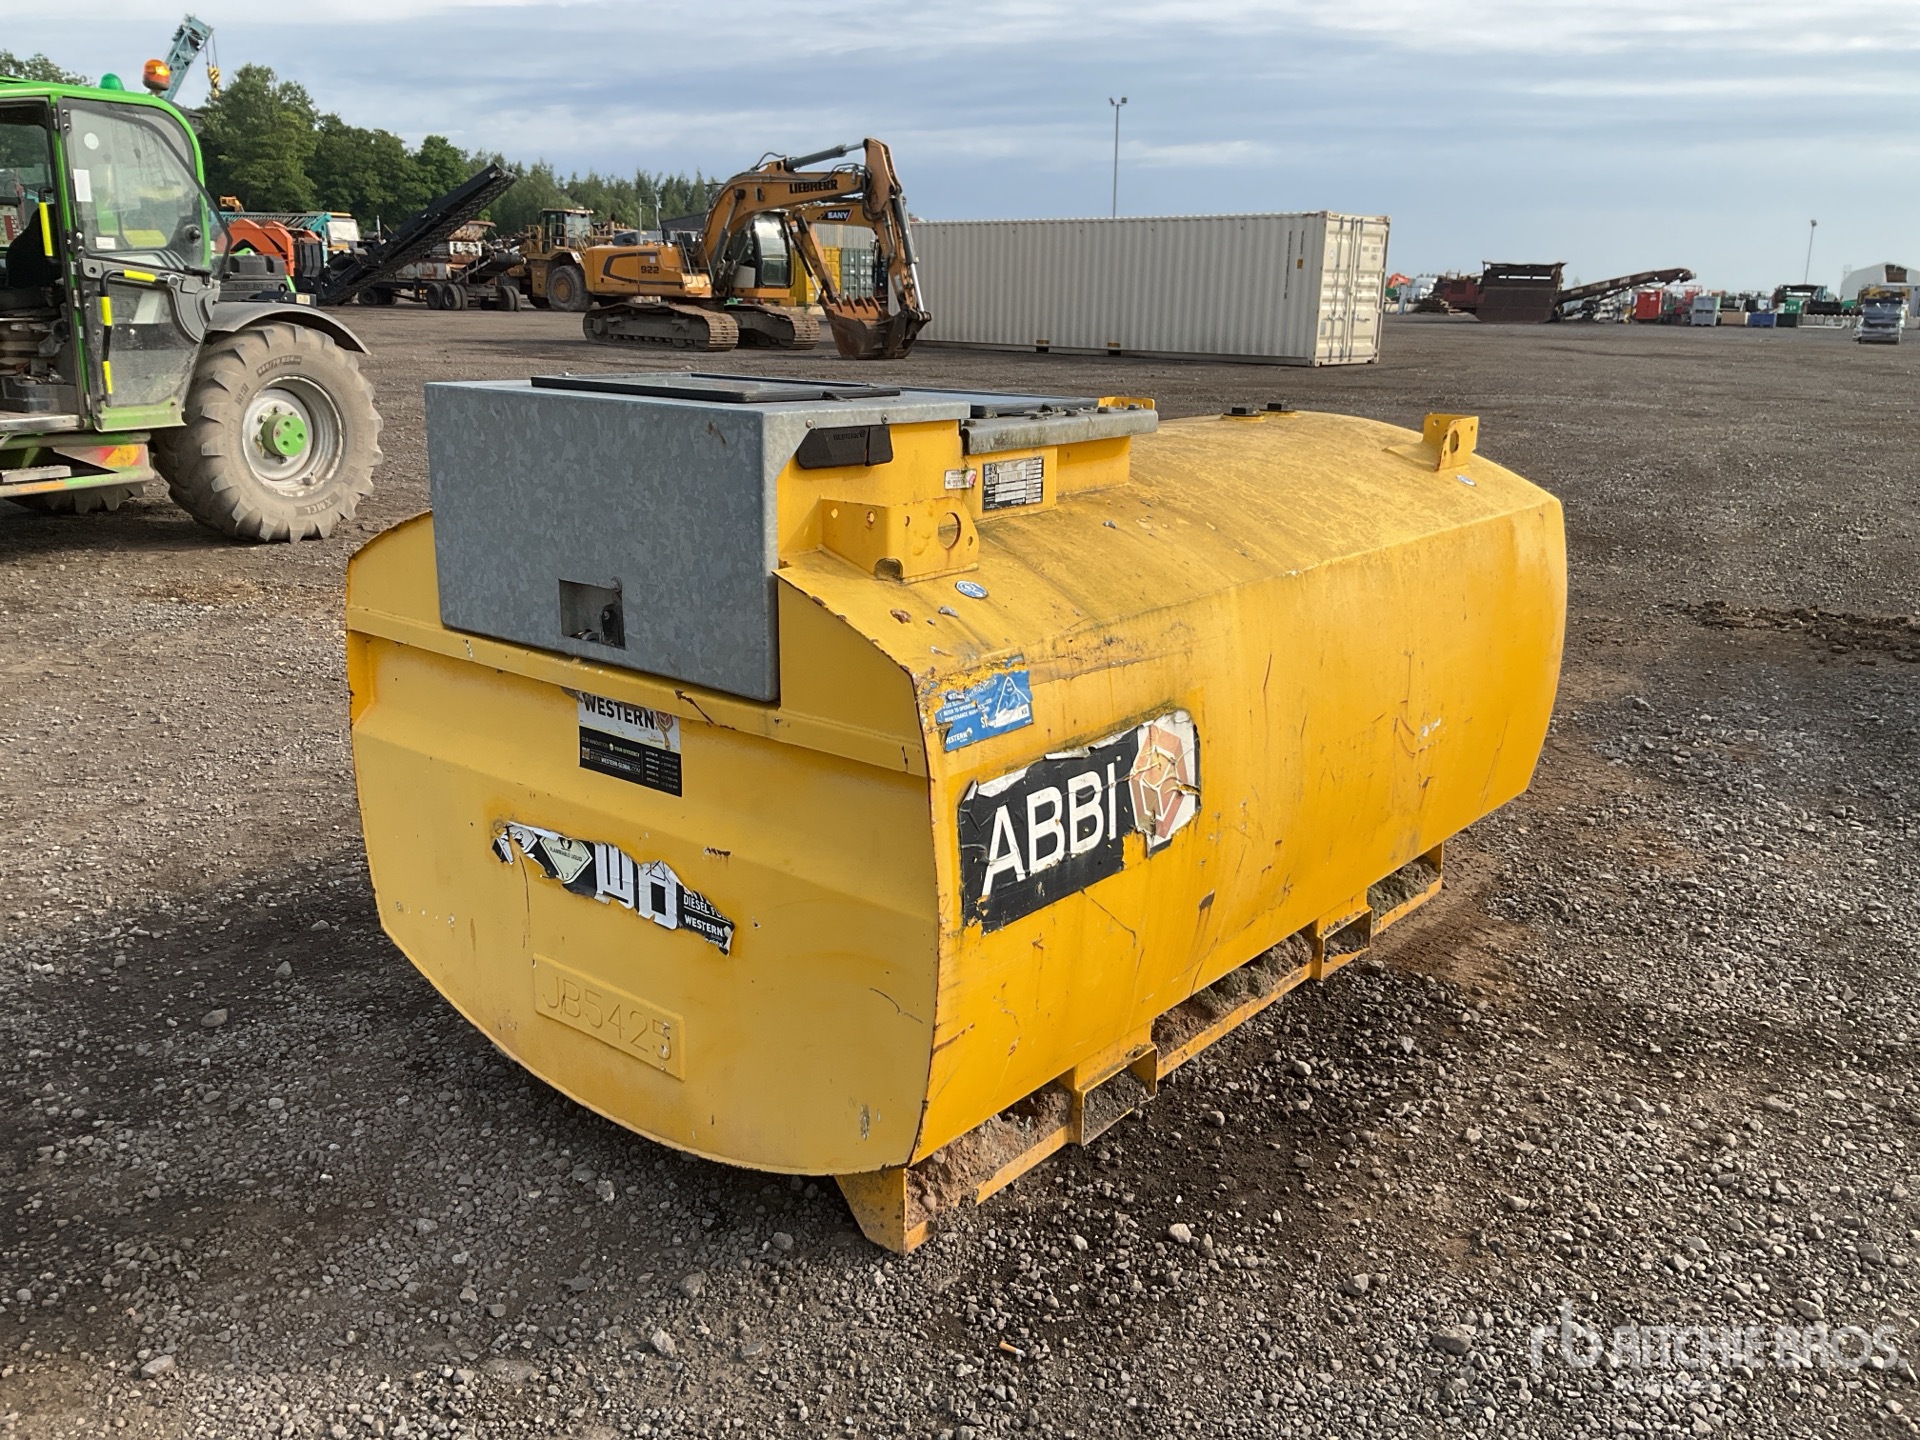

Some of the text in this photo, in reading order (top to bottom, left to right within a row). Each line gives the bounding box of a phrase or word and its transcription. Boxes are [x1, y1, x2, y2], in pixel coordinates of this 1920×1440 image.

[789, 179, 838, 194] LIEBHERR
[827, 211, 849, 219] SANY
[640, 265, 660, 274] 922
[304, 496, 333, 515] XMCL
[582, 691, 655, 730] WESTERN
[981, 761, 1118, 897] ABBI
[683, 894, 710, 914] DIESEL
[684, 913, 724, 937] WESTERN
[542, 976, 672, 1061] JB5425
